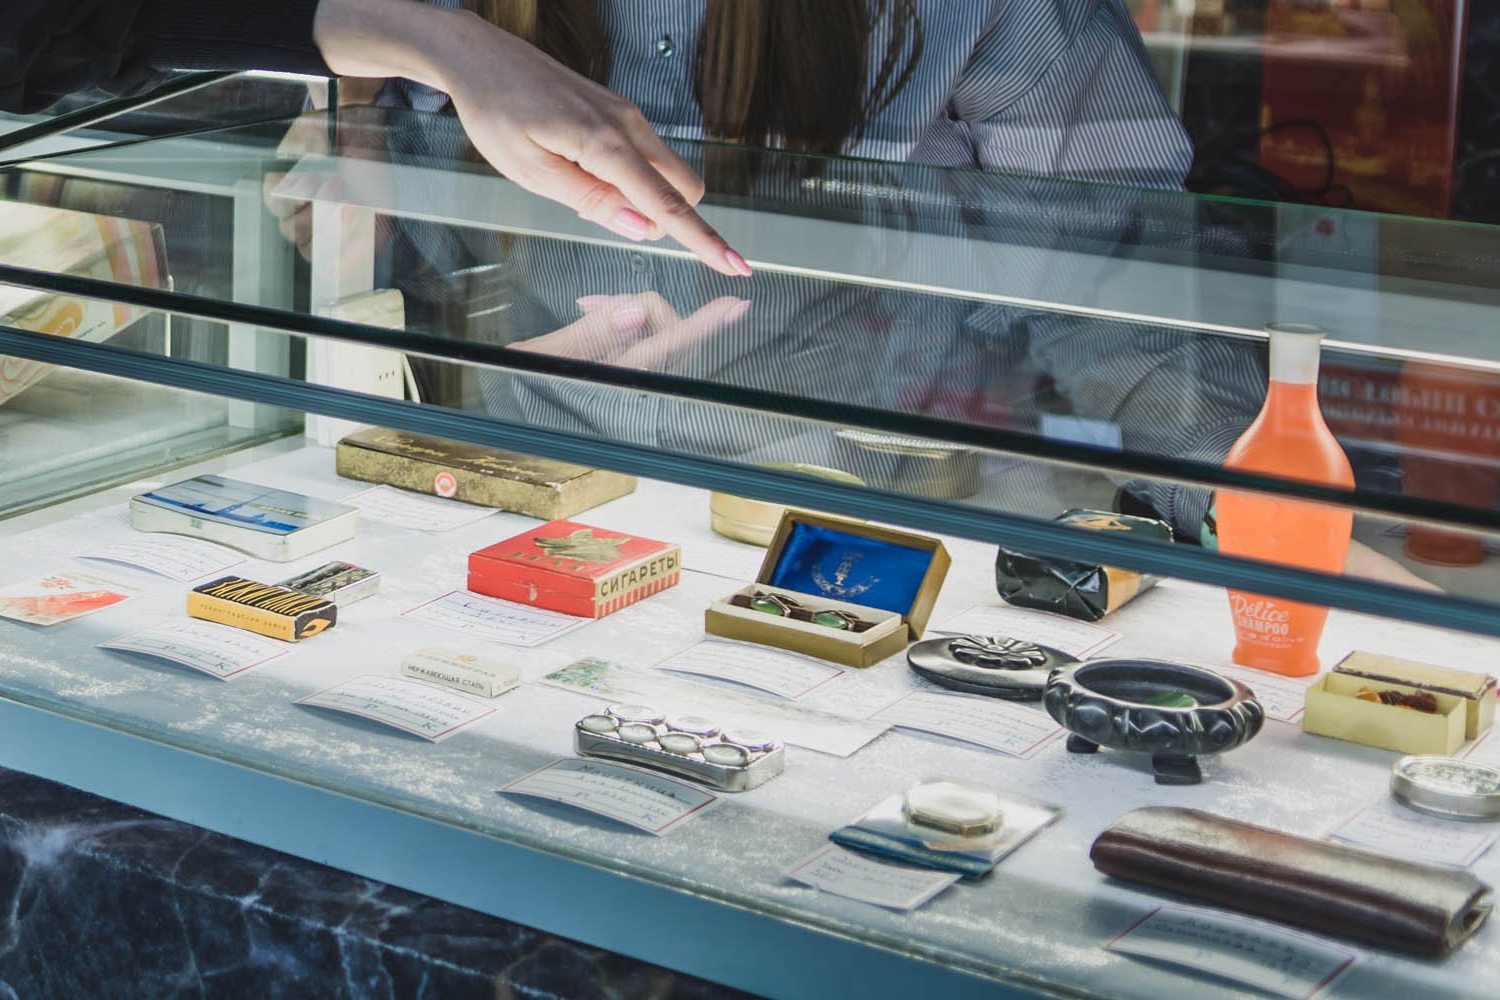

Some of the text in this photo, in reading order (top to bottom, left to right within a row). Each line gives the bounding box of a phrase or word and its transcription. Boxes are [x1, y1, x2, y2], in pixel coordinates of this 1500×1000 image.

[600, 551, 679, 597] СИГАРЕТЫ
[407, 664, 460, 683] НЕРЖАВЕЮЩАЯ
[462, 679, 485, 690] СТАЛЬ
